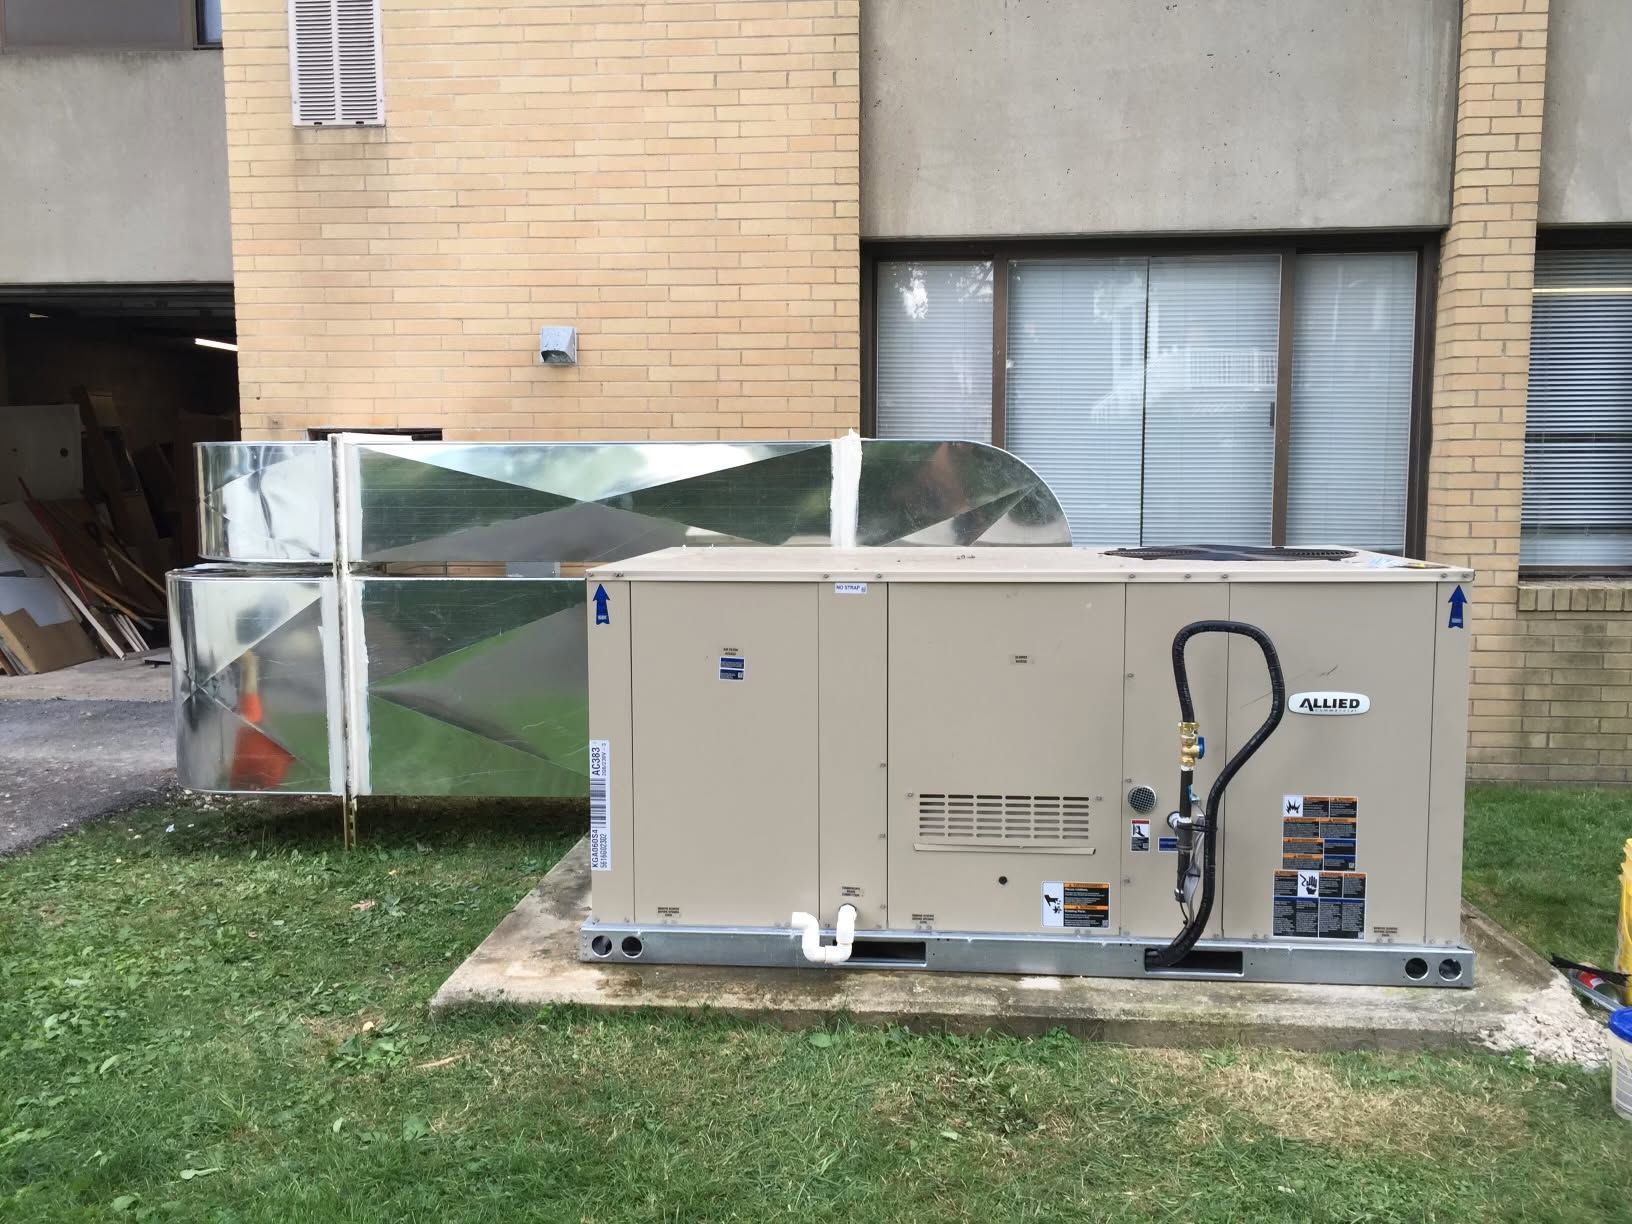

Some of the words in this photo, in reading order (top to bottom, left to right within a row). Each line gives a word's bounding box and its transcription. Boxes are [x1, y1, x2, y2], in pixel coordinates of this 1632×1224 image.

[1299, 698, 1360, 711] ALLIED
[591, 747, 601, 776] AC383
[591, 829, 599, 868] KGA060S4
